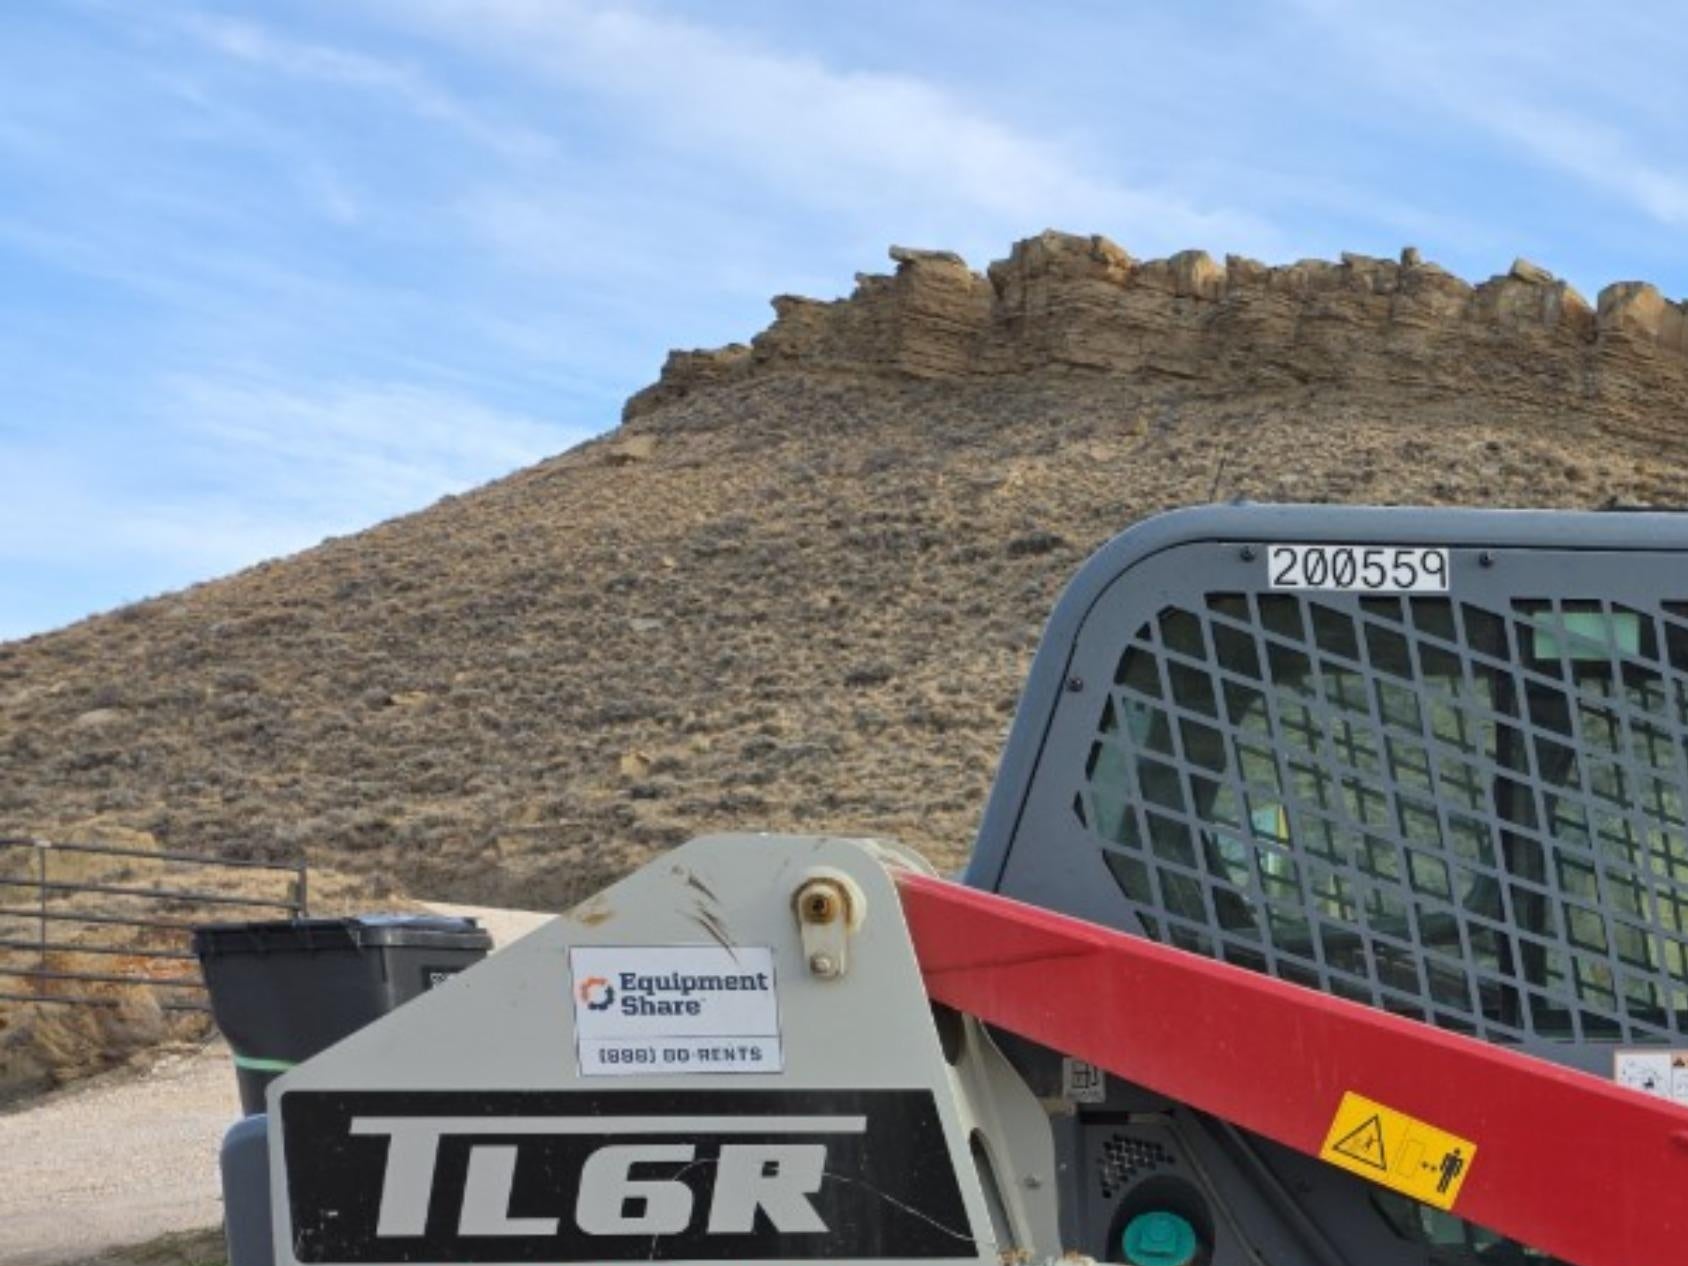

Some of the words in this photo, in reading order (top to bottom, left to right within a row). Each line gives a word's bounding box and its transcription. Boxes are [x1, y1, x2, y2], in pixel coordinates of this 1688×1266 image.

[1274, 548, 1446, 588] 200559
[619, 972, 768, 996] Equipment
[621, 995, 701, 1016] Share
[350, 1116, 867, 1237] TL6R
